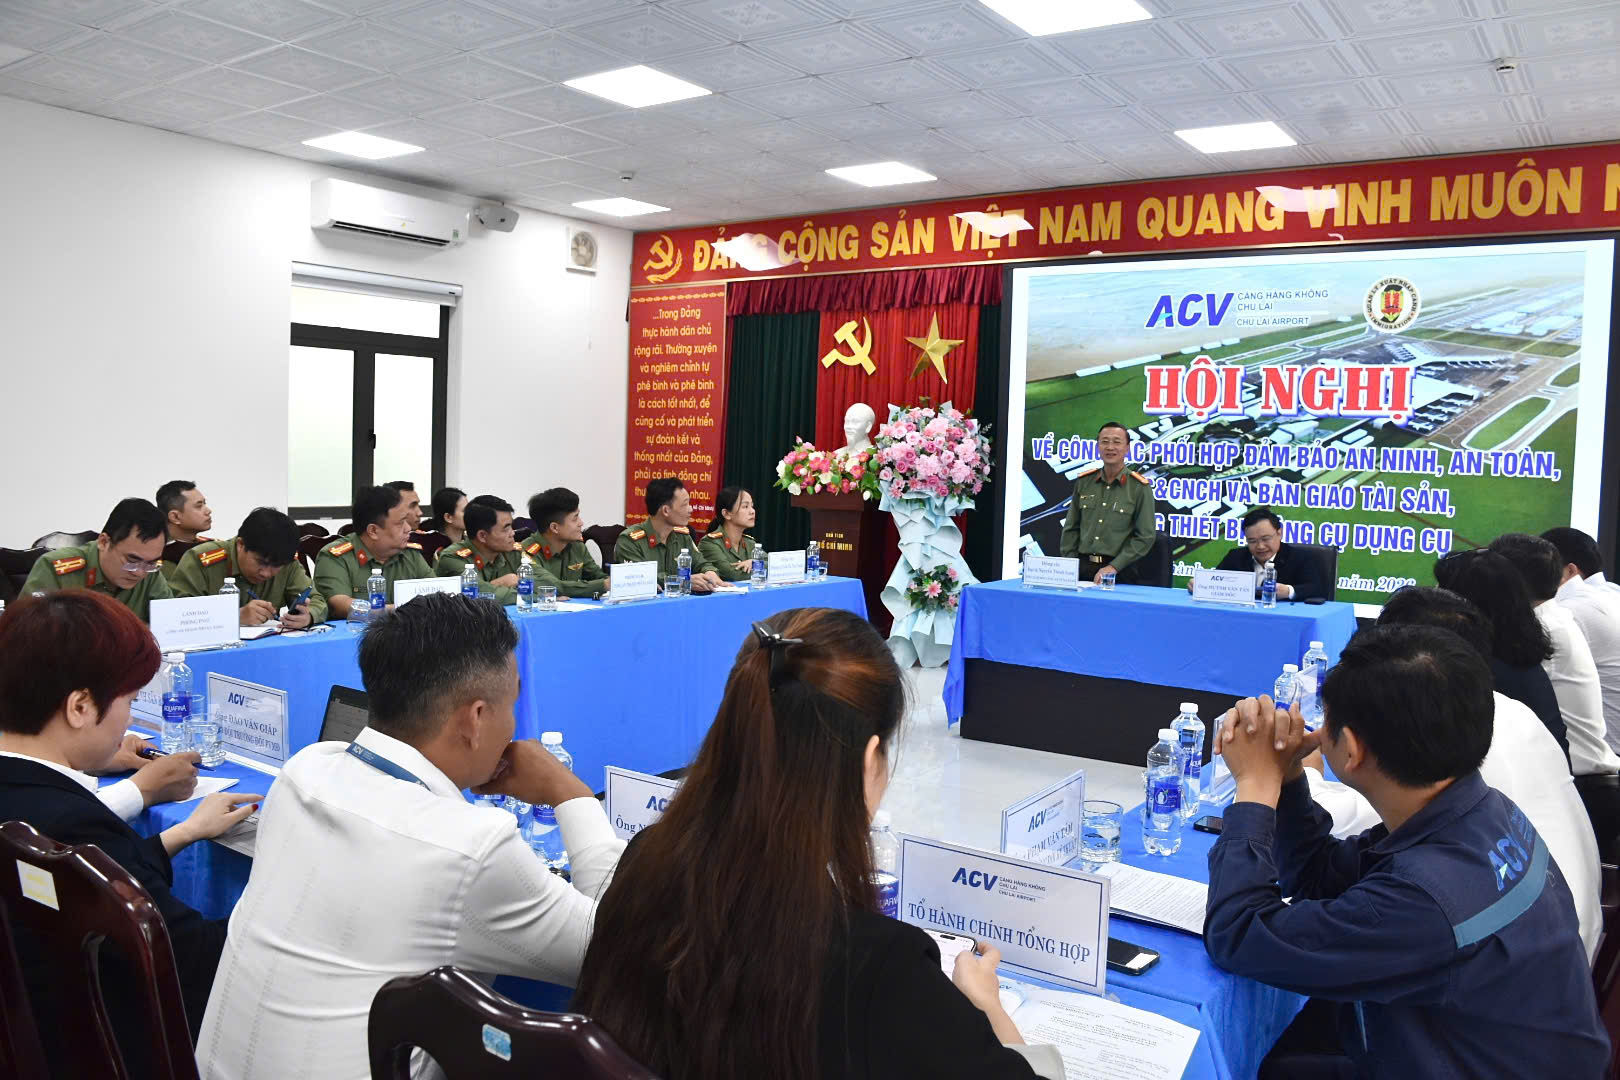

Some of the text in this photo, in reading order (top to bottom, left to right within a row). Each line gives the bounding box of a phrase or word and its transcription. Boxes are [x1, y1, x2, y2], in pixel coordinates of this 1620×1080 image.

[778, 221, 859, 271] CỘNG
[870, 209, 936, 259] SẢN
[1039, 200, 1122, 246] NAM
[1136, 190, 1284, 243] QUANG
[1302, 178, 1412, 230] VINH
[1430, 158, 1583, 221] MUÔN
[1295, 288, 1329, 299] KHÔNG
[681, 305, 701, 320] Đảng
[1145, 293, 1234, 327] ACV
[1238, 303, 1273, 311] CHU LAI
[1237, 317, 1309, 326] CHU LAI AIRPORT
[1144, 355, 1411, 420] HỘI NGHỊ
[1033, 433, 1054, 459] VỀ
[1151, 437, 1194, 464] PHỐI
[1200, 443, 1238, 471] HỢP
[1245, 437, 1290, 467] ĐẢM
[1297, 439, 1338, 469] BẢO
[1345, 447, 1376, 470] AN
[1382, 448, 1444, 476] NINH,
[1450, 450, 1483, 474] AN
[1490, 447, 1560, 481] TOÀN,
[1226, 475, 1252, 504] VÀ
[1259, 478, 1299, 505] BÀN
[1307, 484, 1355, 508] GIAO
[1361, 482, 1394, 510] TÀI
[1402, 480, 1455, 516] SẢN,
[1170, 511, 1220, 539] THIẾT
[1320, 524, 1348, 550] CỤ
[1354, 526, 1413, 554] DỤNG
[1421, 529, 1453, 557] CỤ
[1340, 575, 1373, 589] năm
[228, 692, 245, 706] ACV
[616, 814, 636, 834] Ông
[1028, 808, 1047, 833] ACV
[952, 867, 998, 892] ACV
[908, 898, 926, 920] TỔ
[928, 906, 966, 932] HÀNH
[969, 918, 1013, 944] CHÍNH
[1016, 925, 1056, 955] TỔNG
[1059, 942, 1091, 965] HỢP
